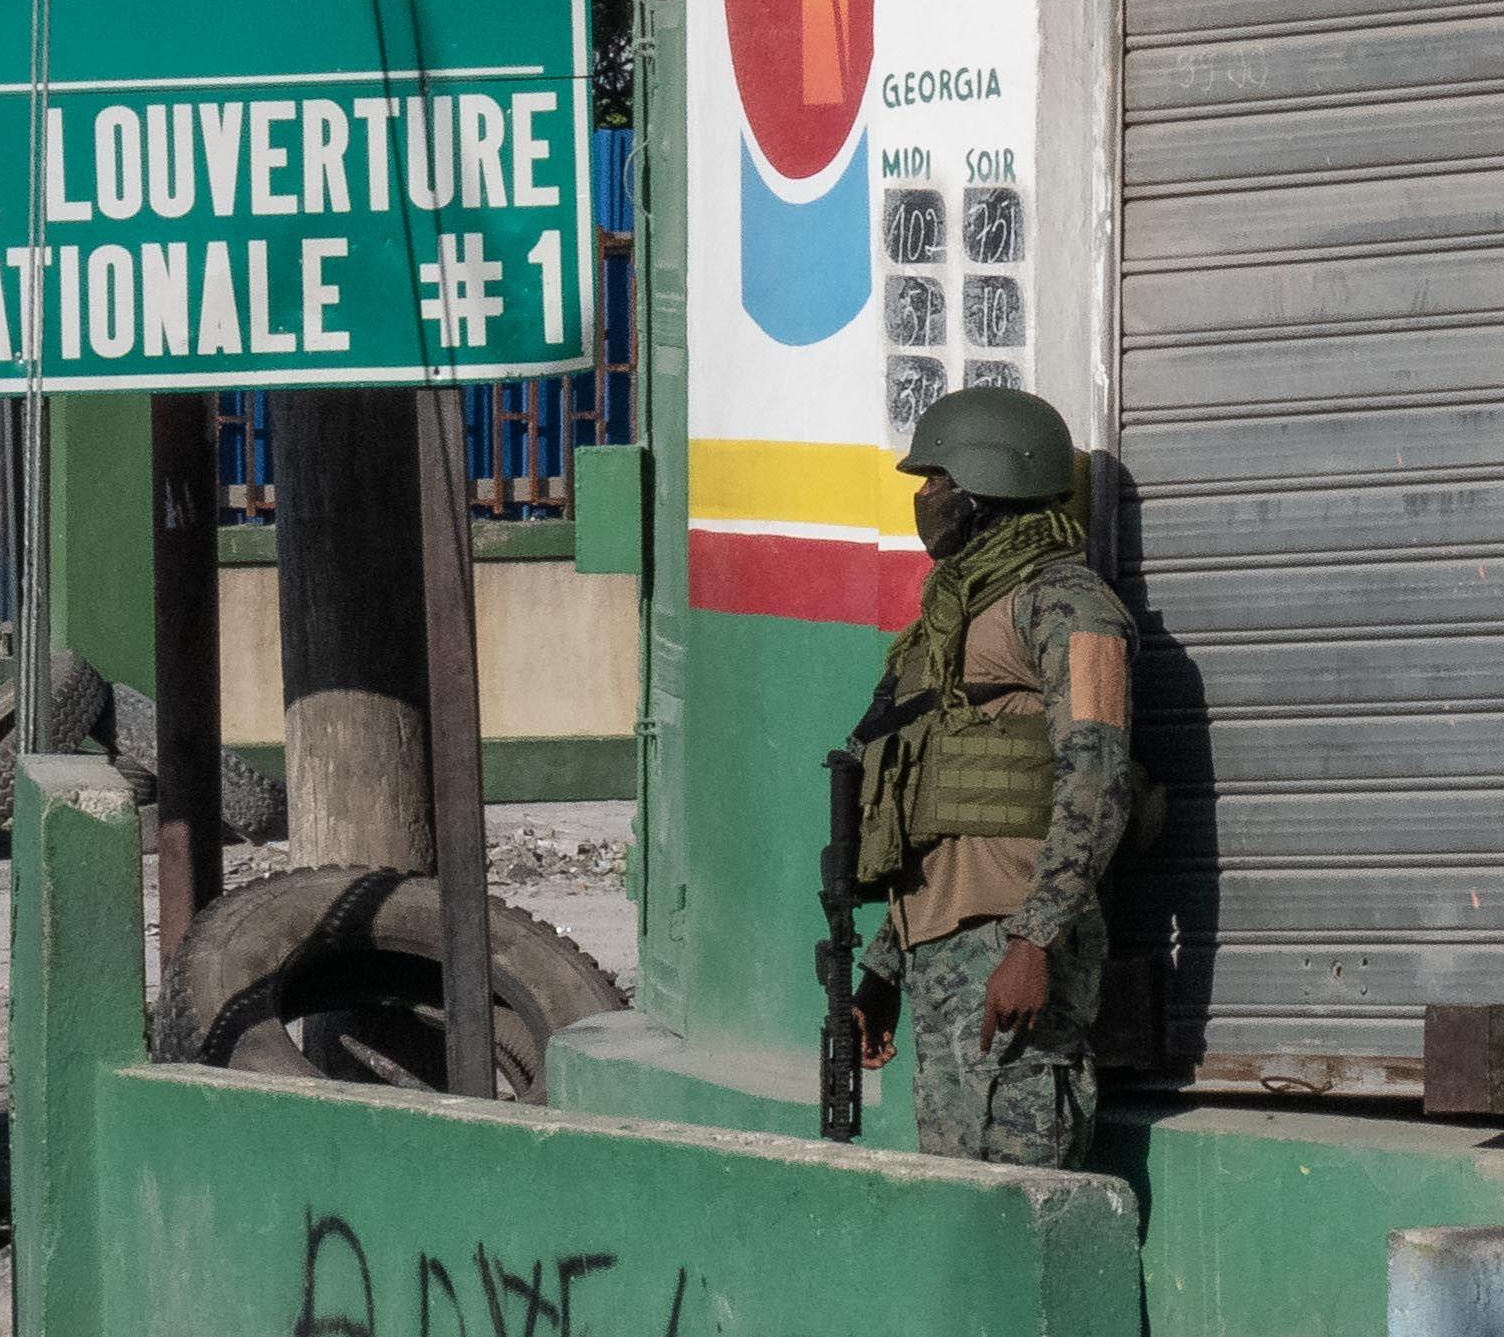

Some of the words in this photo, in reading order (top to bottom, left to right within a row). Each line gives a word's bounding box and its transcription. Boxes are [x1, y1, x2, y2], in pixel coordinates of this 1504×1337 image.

[882, 67, 1002, 109] GEORGIA
[46, 92, 560, 222] LOUVERTURE
[882, 146, 931, 181] MIDI
[966, 147, 1016, 183] SOIR
